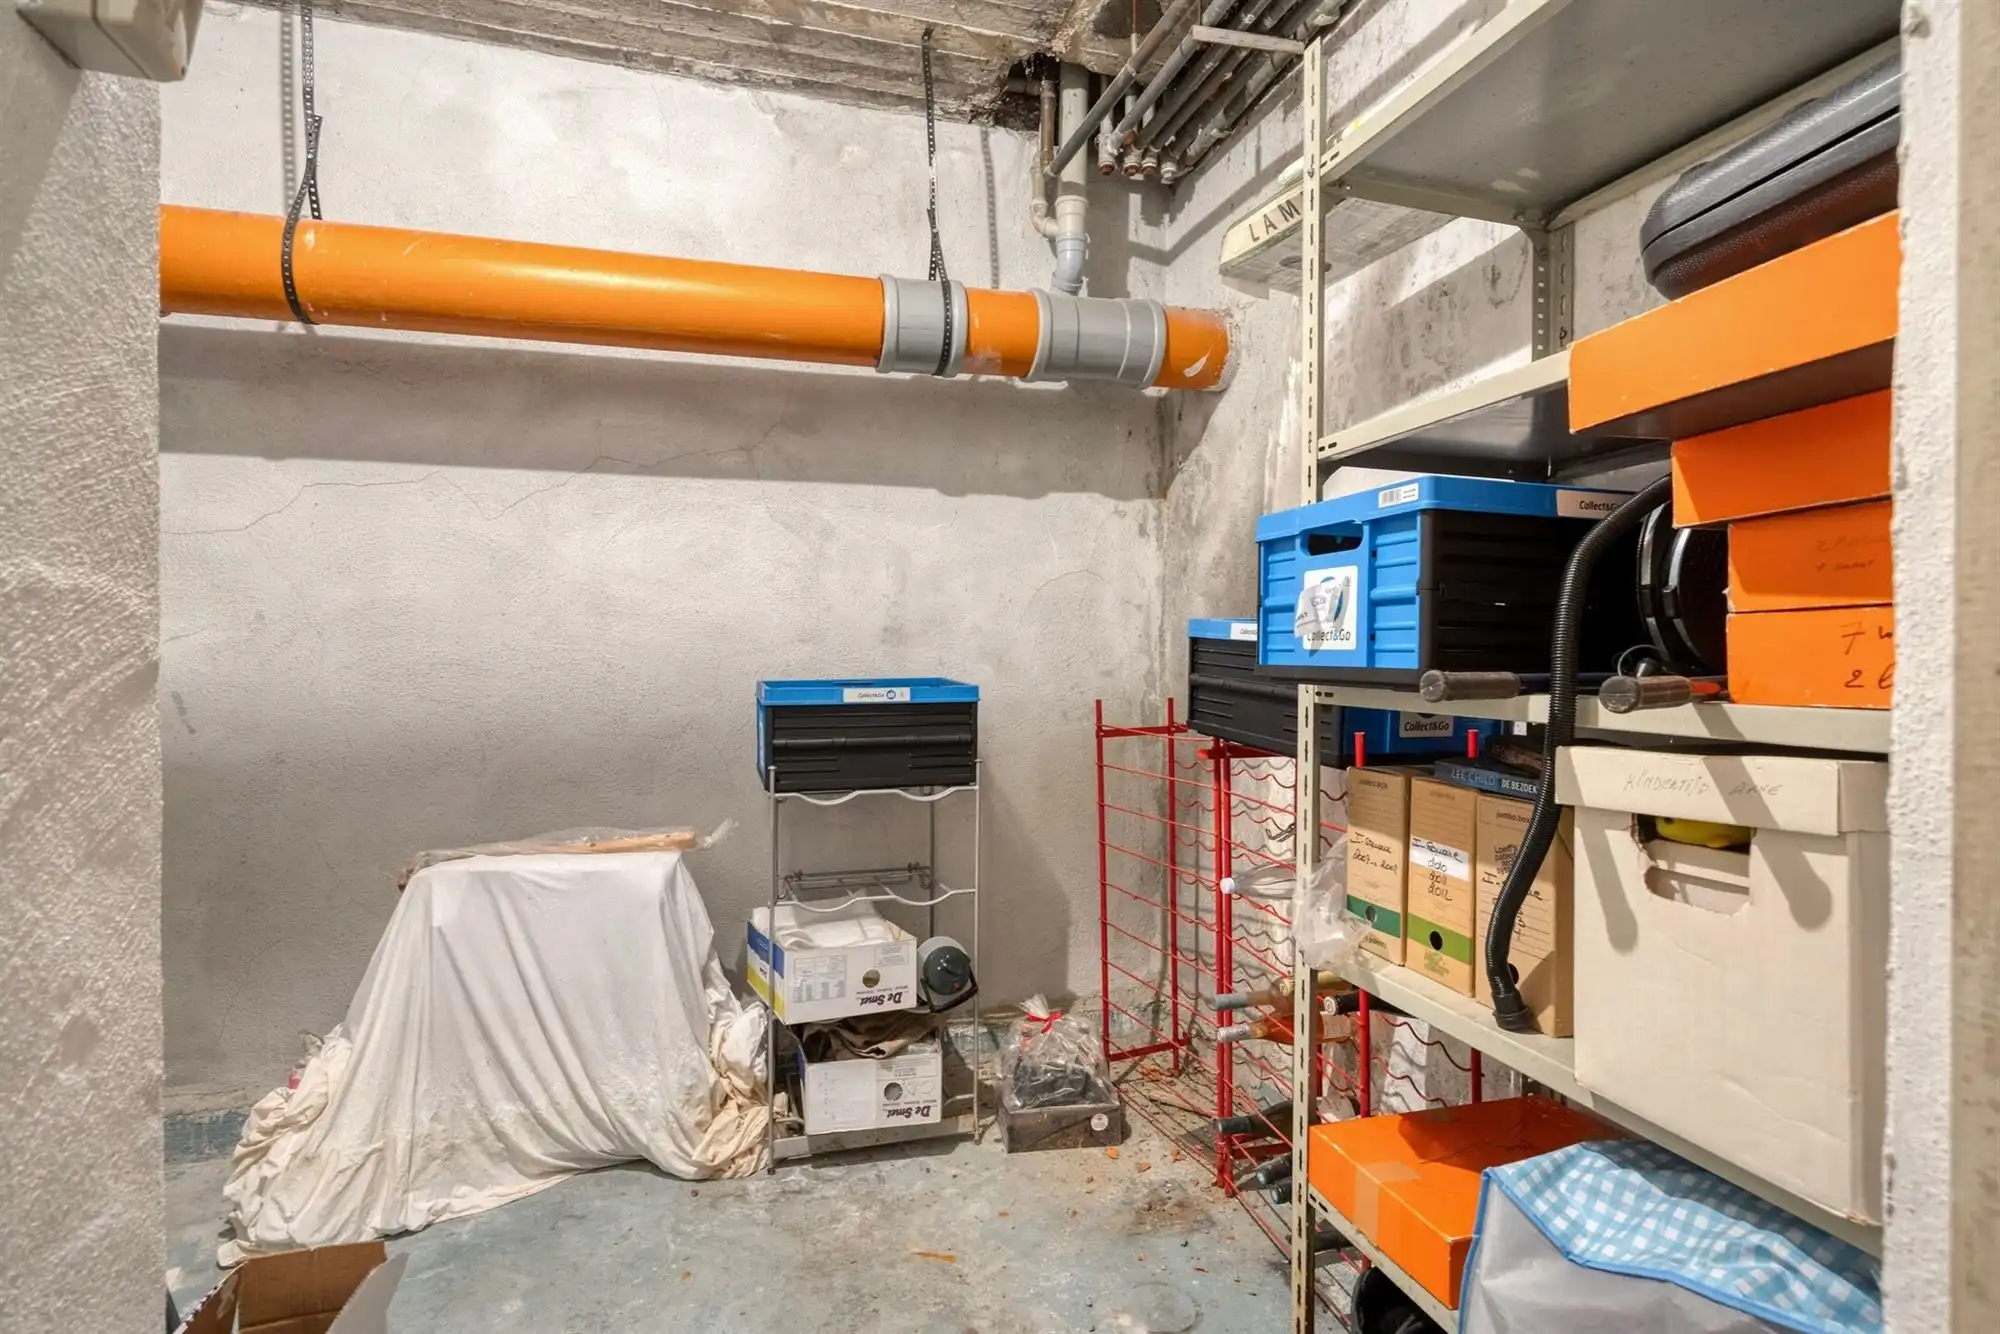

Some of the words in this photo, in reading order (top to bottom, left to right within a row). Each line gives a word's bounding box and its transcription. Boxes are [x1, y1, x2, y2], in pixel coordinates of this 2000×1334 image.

[1248, 199, 1303, 242] LAM
[1404, 721, 1450, 731] Collect&Go
[1452, 768, 1467, 780] LEE
[1467, 771, 1496, 786] CHILD
[1501, 779, 1510, 789] DE
[860, 994, 886, 1007] Smet
[887, 991, 903, 1004] De
[886, 1107, 913, 1119] Smet
[915, 1105, 931, 1117] De
